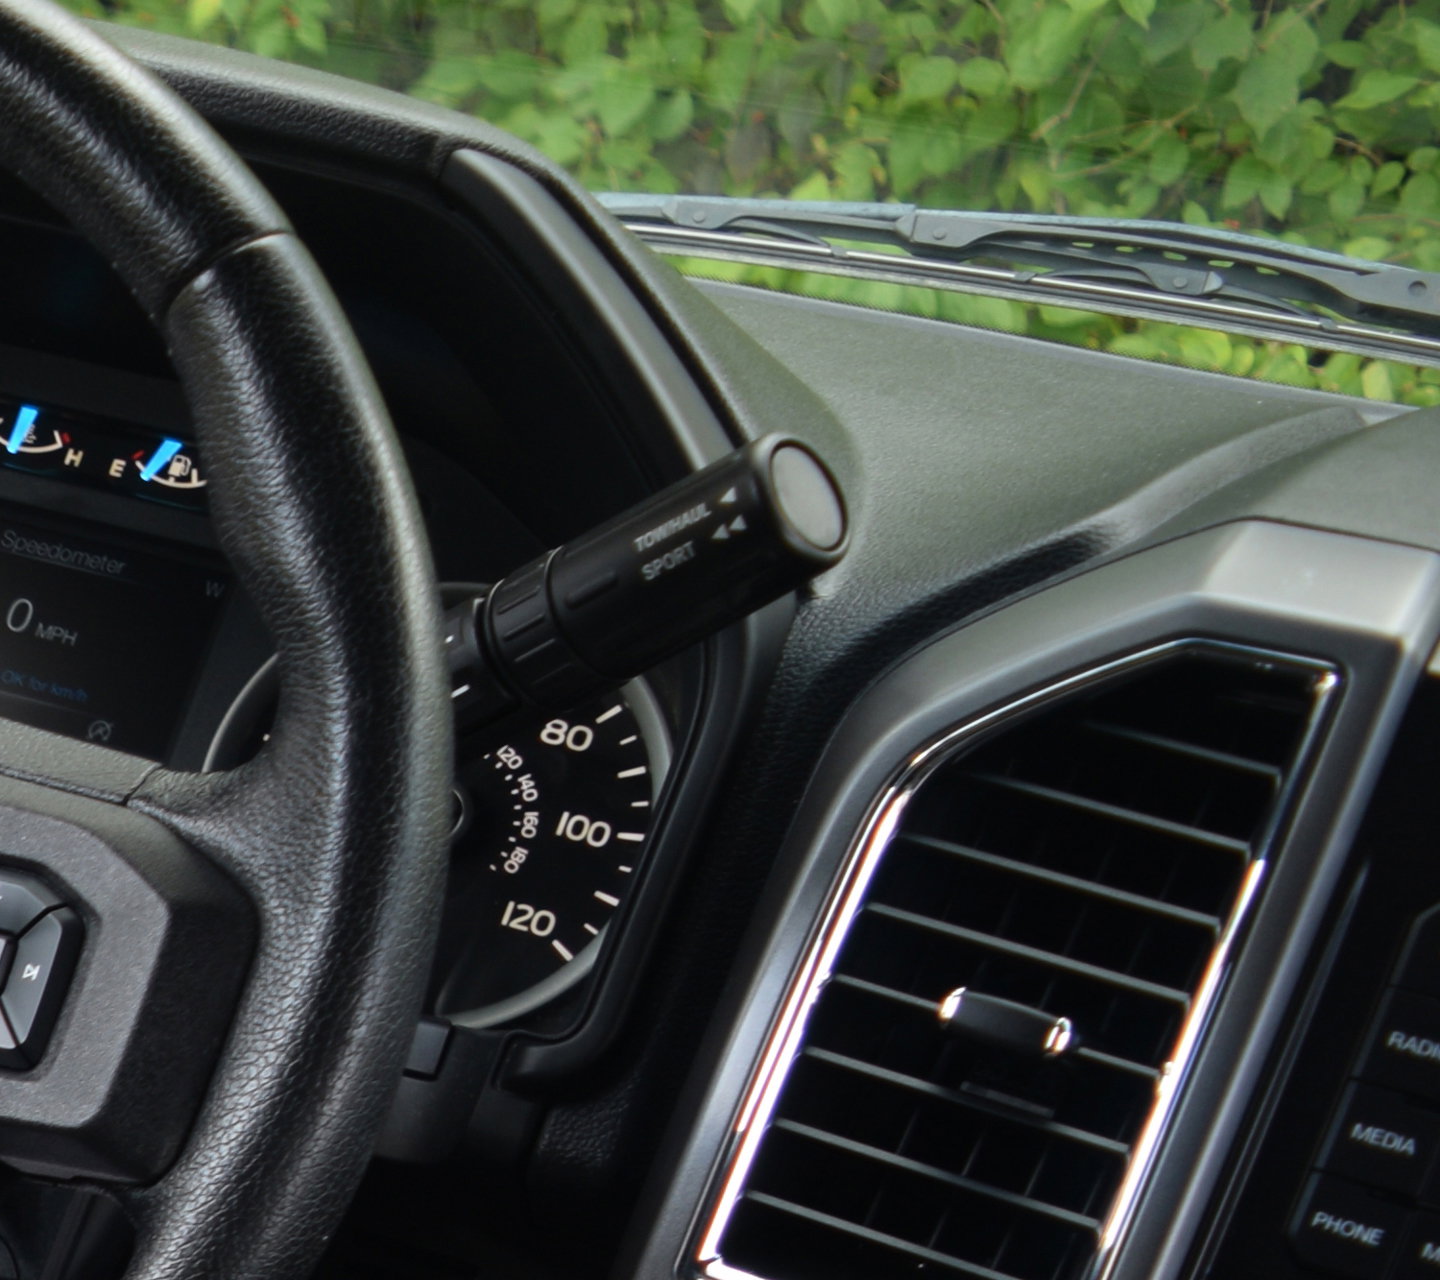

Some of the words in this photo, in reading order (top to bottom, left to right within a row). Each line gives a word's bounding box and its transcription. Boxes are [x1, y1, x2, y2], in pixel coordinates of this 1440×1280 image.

[64, 448, 83, 467] H
[109, 459, 126, 479] E
[0, 531, 127, 577] Speedometer
[641, 540, 696, 581] SPORT
[5, 597, 35, 634] 0
[34, 622, 79, 648] MPH
[539, 717, 594, 752] 80
[495, 744, 524, 771] 120
[517, 773, 539, 803] 140
[520, 811, 539, 840] 160
[555, 810, 612, 849] 100
[503, 846, 529, 875] 180
[500, 900, 557, 938] 120
[1387, 1030, 1440, 1061] RADI
[1349, 1122, 1417, 1156] MEDIA
[1311, 1210, 1385, 1246] PHONE
